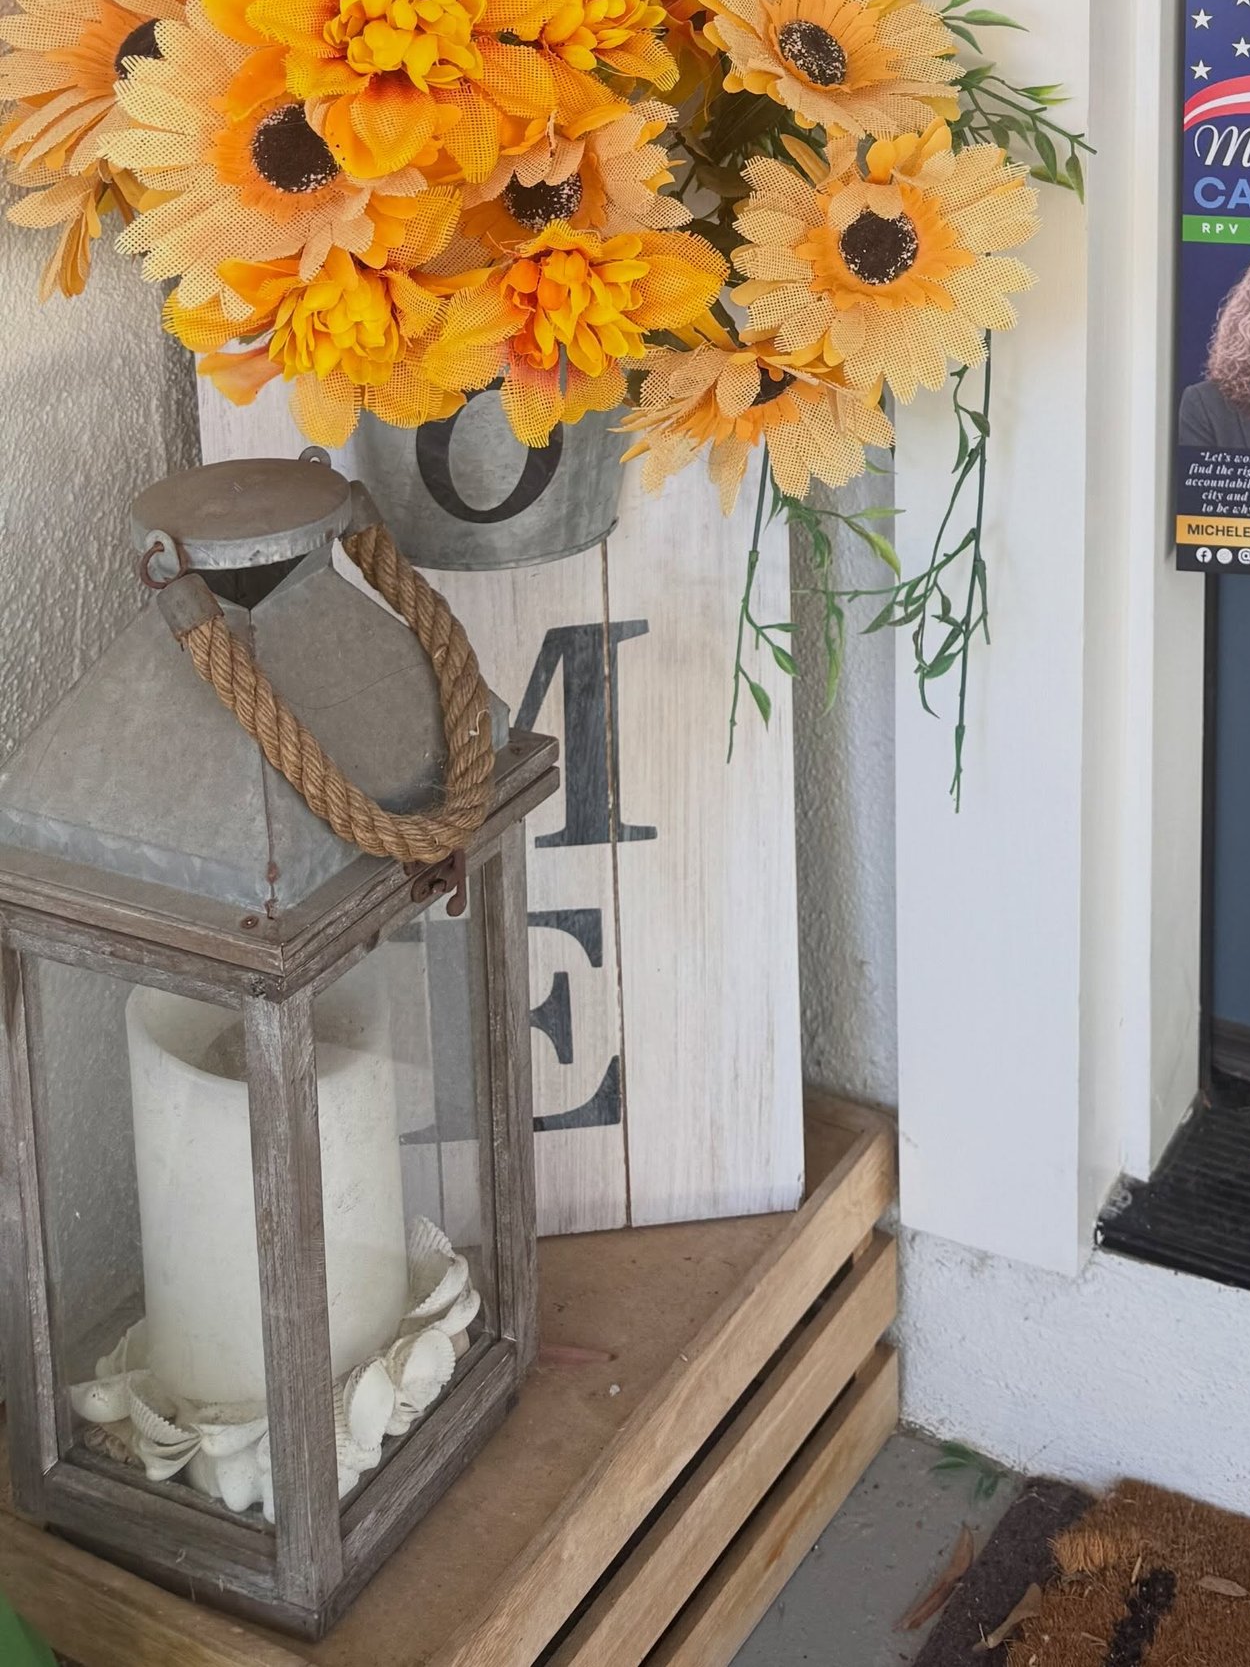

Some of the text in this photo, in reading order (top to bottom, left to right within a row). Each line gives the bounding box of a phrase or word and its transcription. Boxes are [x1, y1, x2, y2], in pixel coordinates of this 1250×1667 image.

[1201, 222, 1239, 235] RPV
[1188, 463, 1213, 475] find
[1216, 464, 1234, 475] the
[1201, 489, 1223, 502] city
[1226, 491, 1249, 502] and
[1202, 503, 1214, 513] to
[1216, 502, 1229, 513] be
